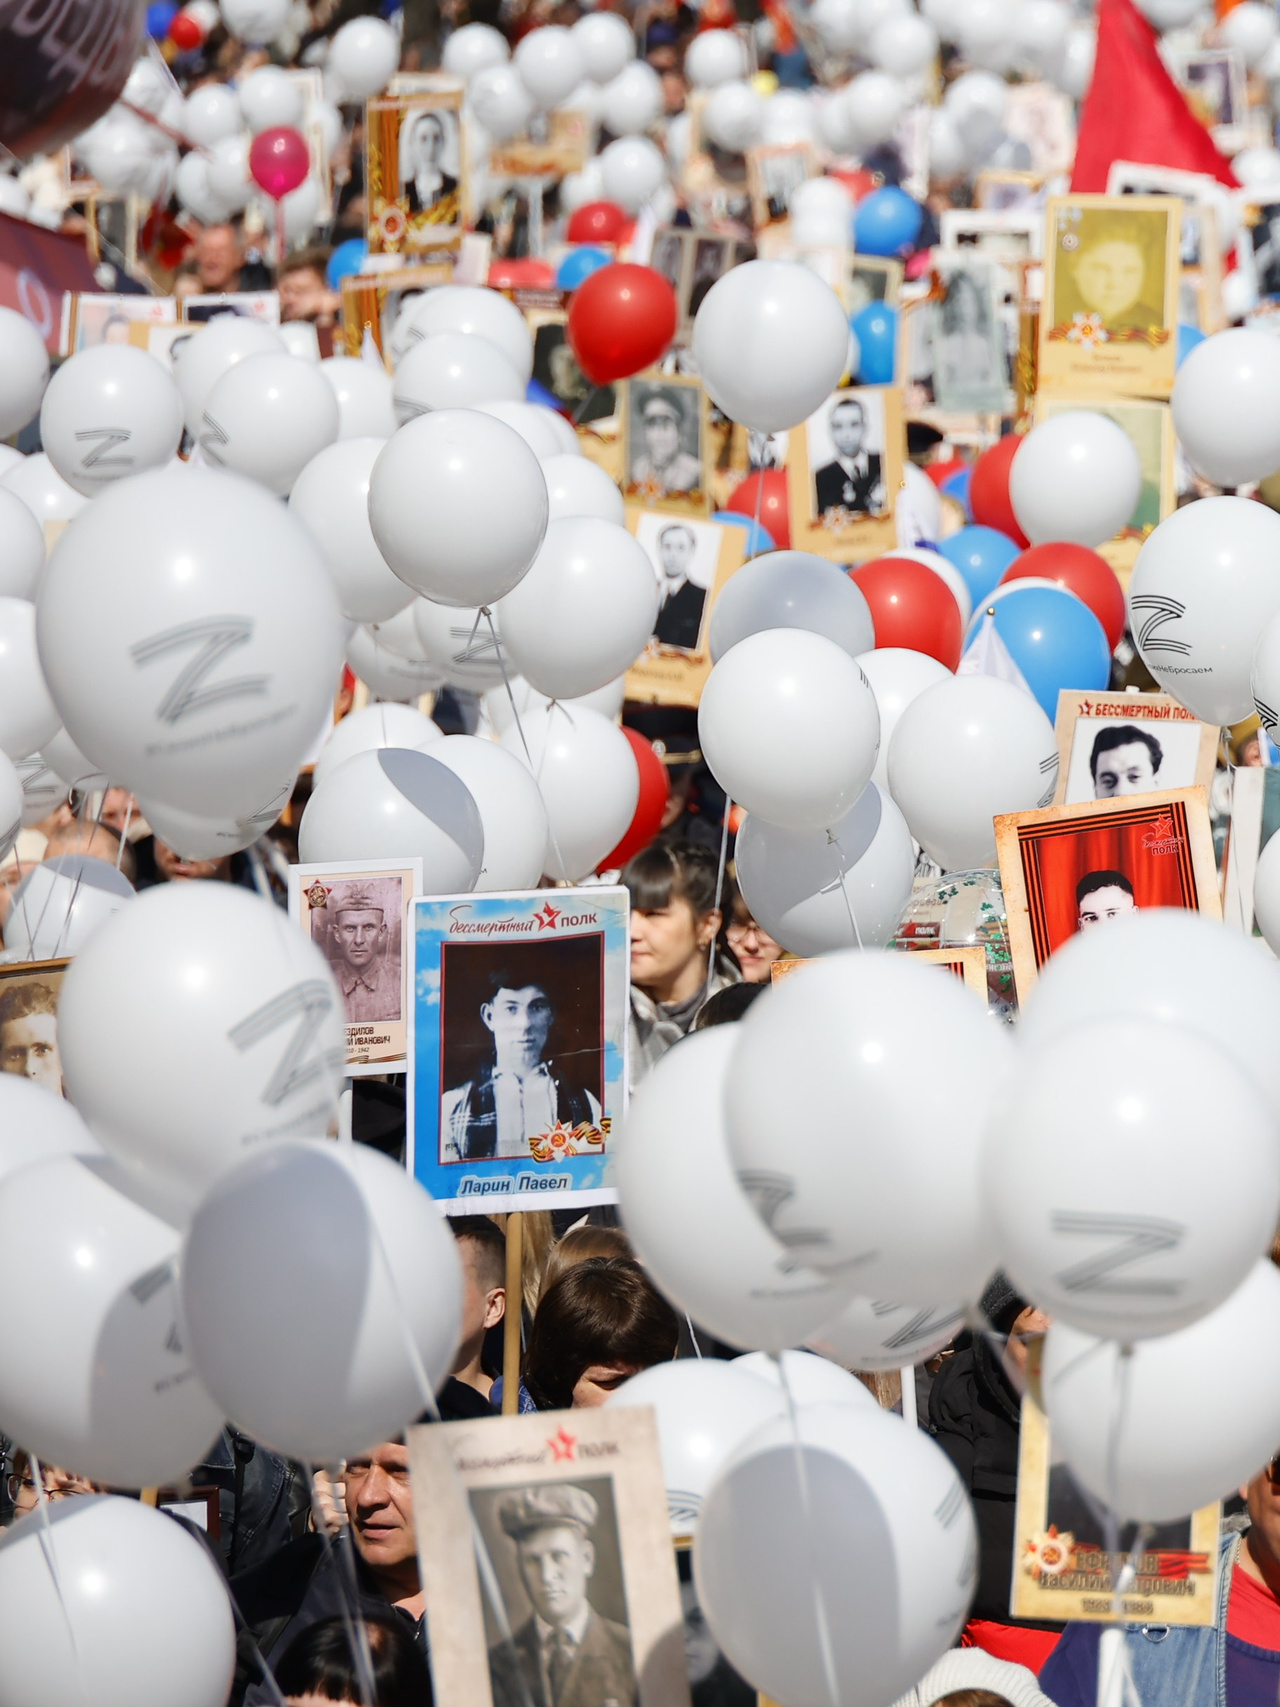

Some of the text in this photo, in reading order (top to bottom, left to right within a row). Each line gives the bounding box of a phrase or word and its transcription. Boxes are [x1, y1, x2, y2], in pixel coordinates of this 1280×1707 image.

[1131, 594, 1192, 656] Z
[1095, 703, 1171, 719] БЕССМЕРТНЫЙ
[561, 913, 597, 927] ПОЛК
[354, 1036, 391, 1045] ИВАНОВИЧ
[461, 1176, 568, 1195] Ларин Павел
